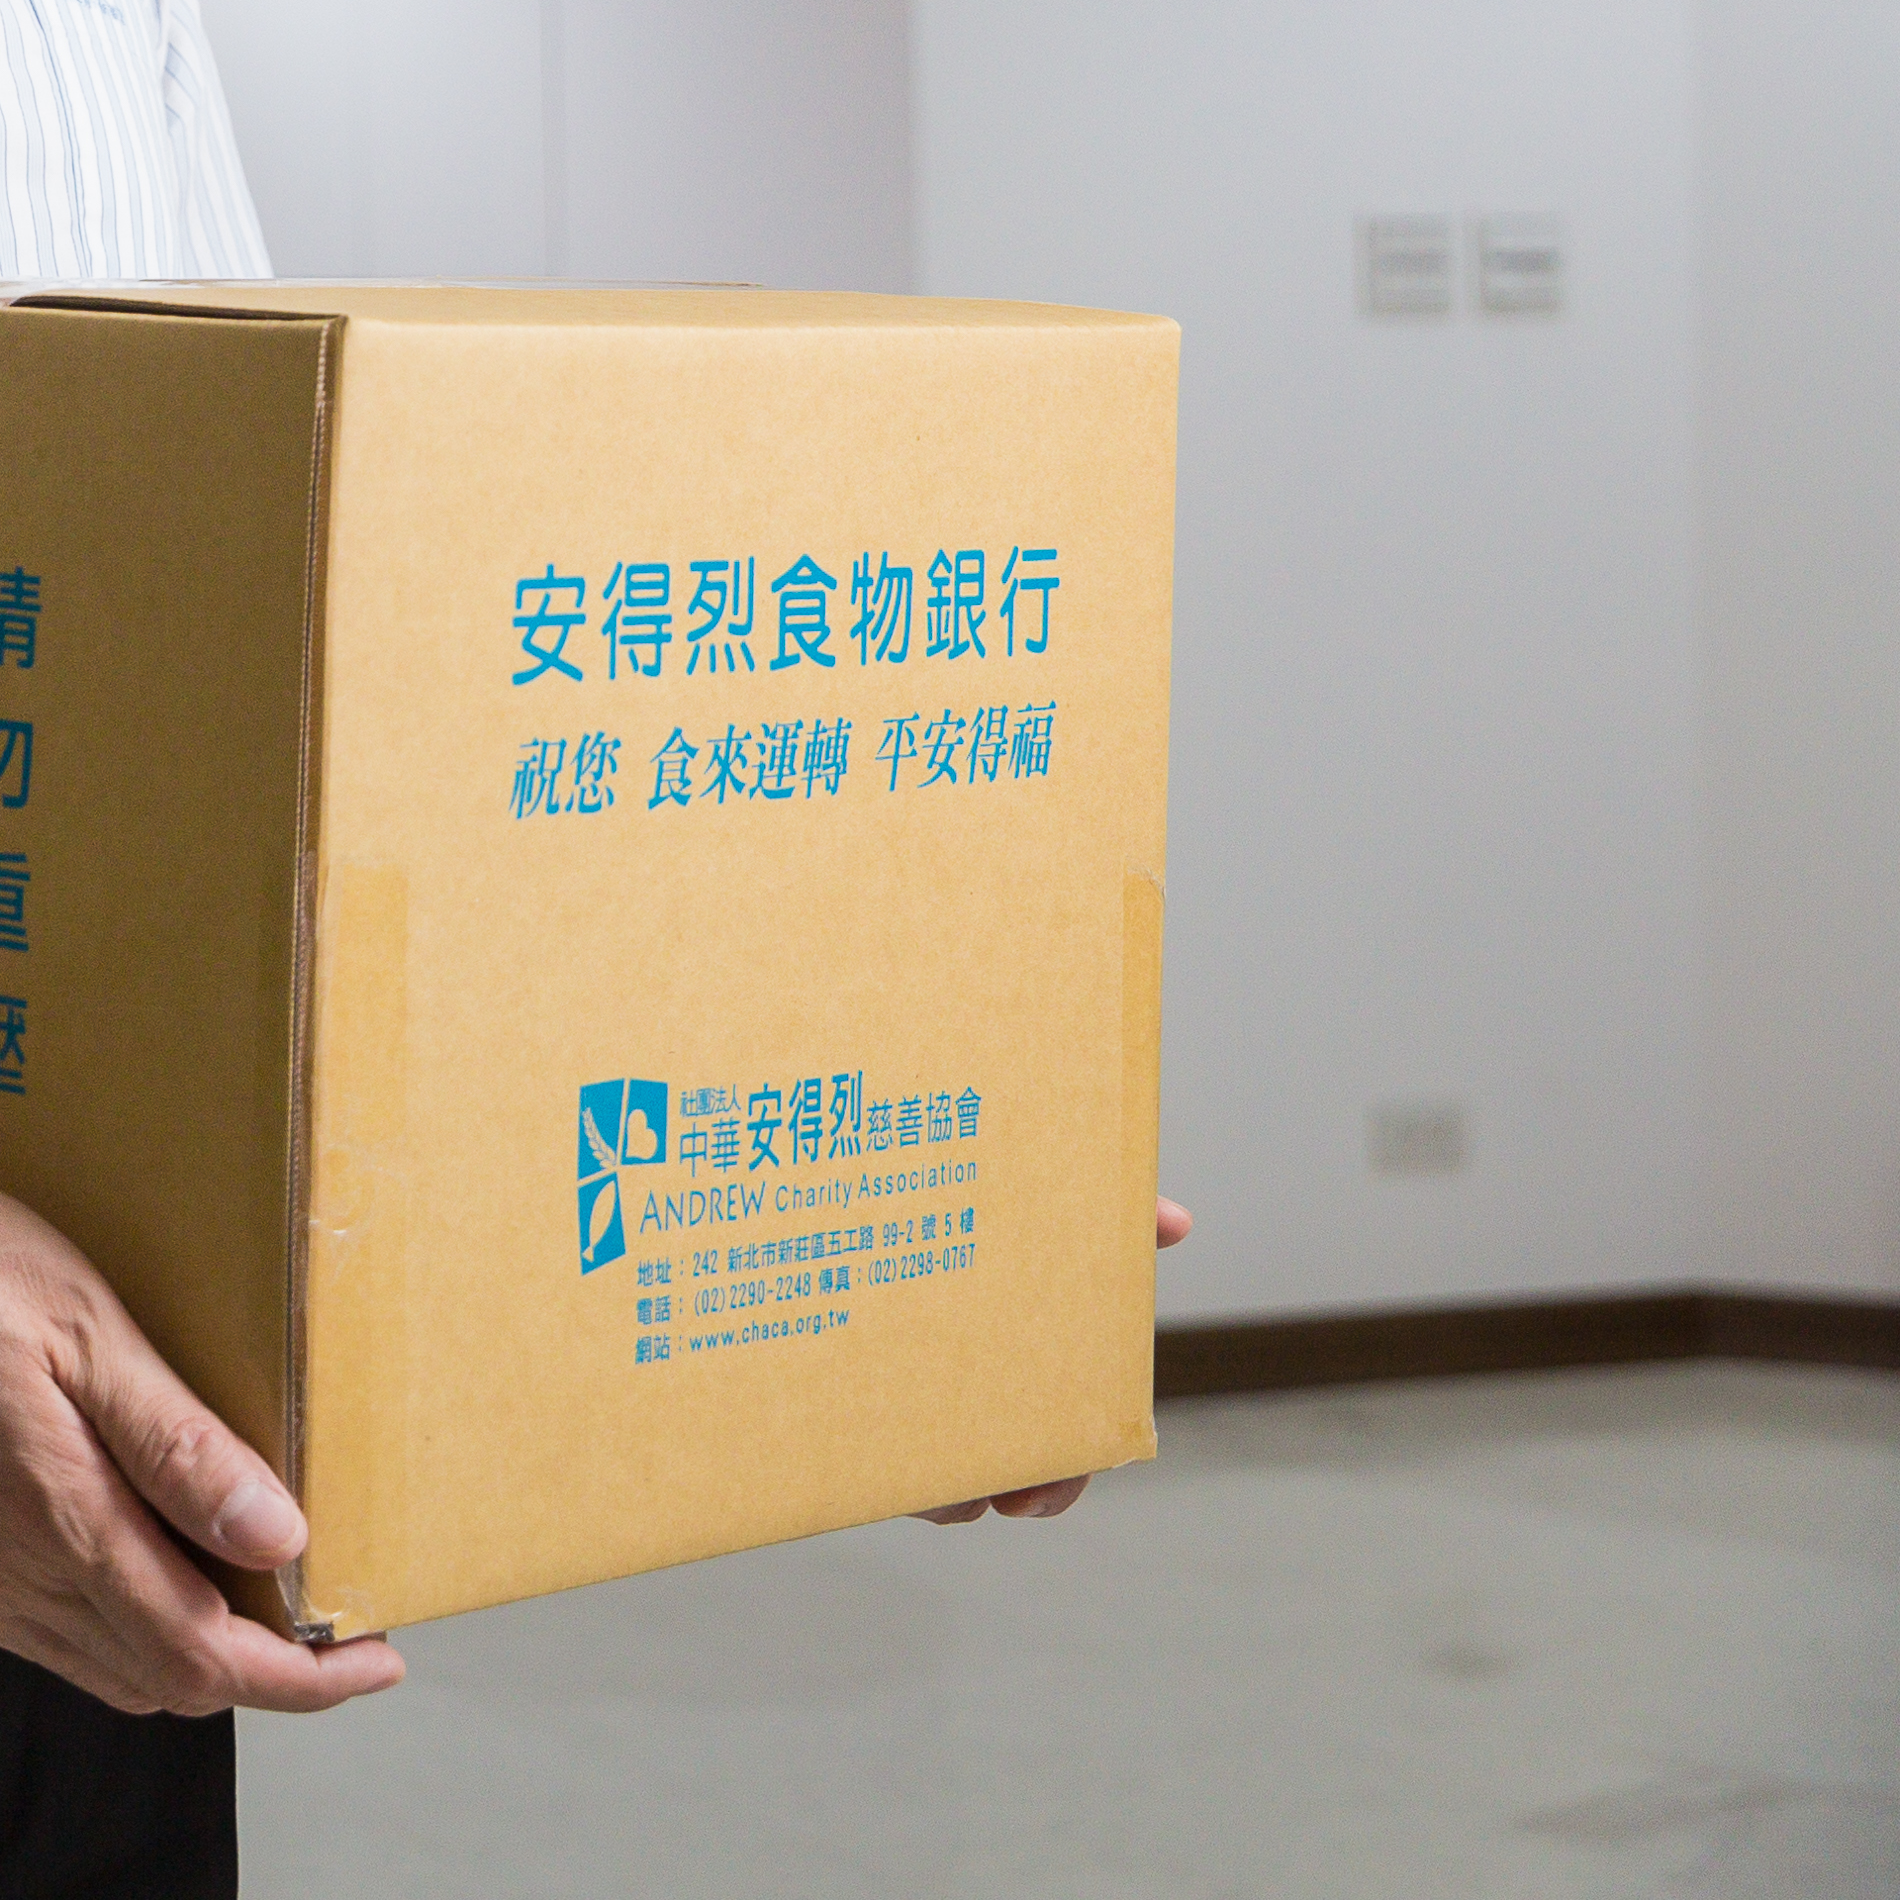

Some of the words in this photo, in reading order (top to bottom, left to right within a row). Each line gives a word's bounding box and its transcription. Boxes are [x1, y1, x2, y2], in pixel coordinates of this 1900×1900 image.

[511, 545, 1061, 687] 安得烈食物銀行
[509, 730, 622, 820] 祝您
[647, 717, 853, 811] 食來運轉
[875, 700, 1057, 792] 平安得福
[680, 1084, 742, 1117] 社團法人
[640, 1181, 766, 1233] ANDREW
[775, 1180, 852, 1212] Charity
[858, 1162, 976, 1198] Association
[693, 1249, 718, 1278] 242
[728, 1225, 874, 1272] 新北市新莊區五工路
[883, 1220, 913, 1247] 99-2
[690, 1310, 849, 1351] www.chaca.org.tw
